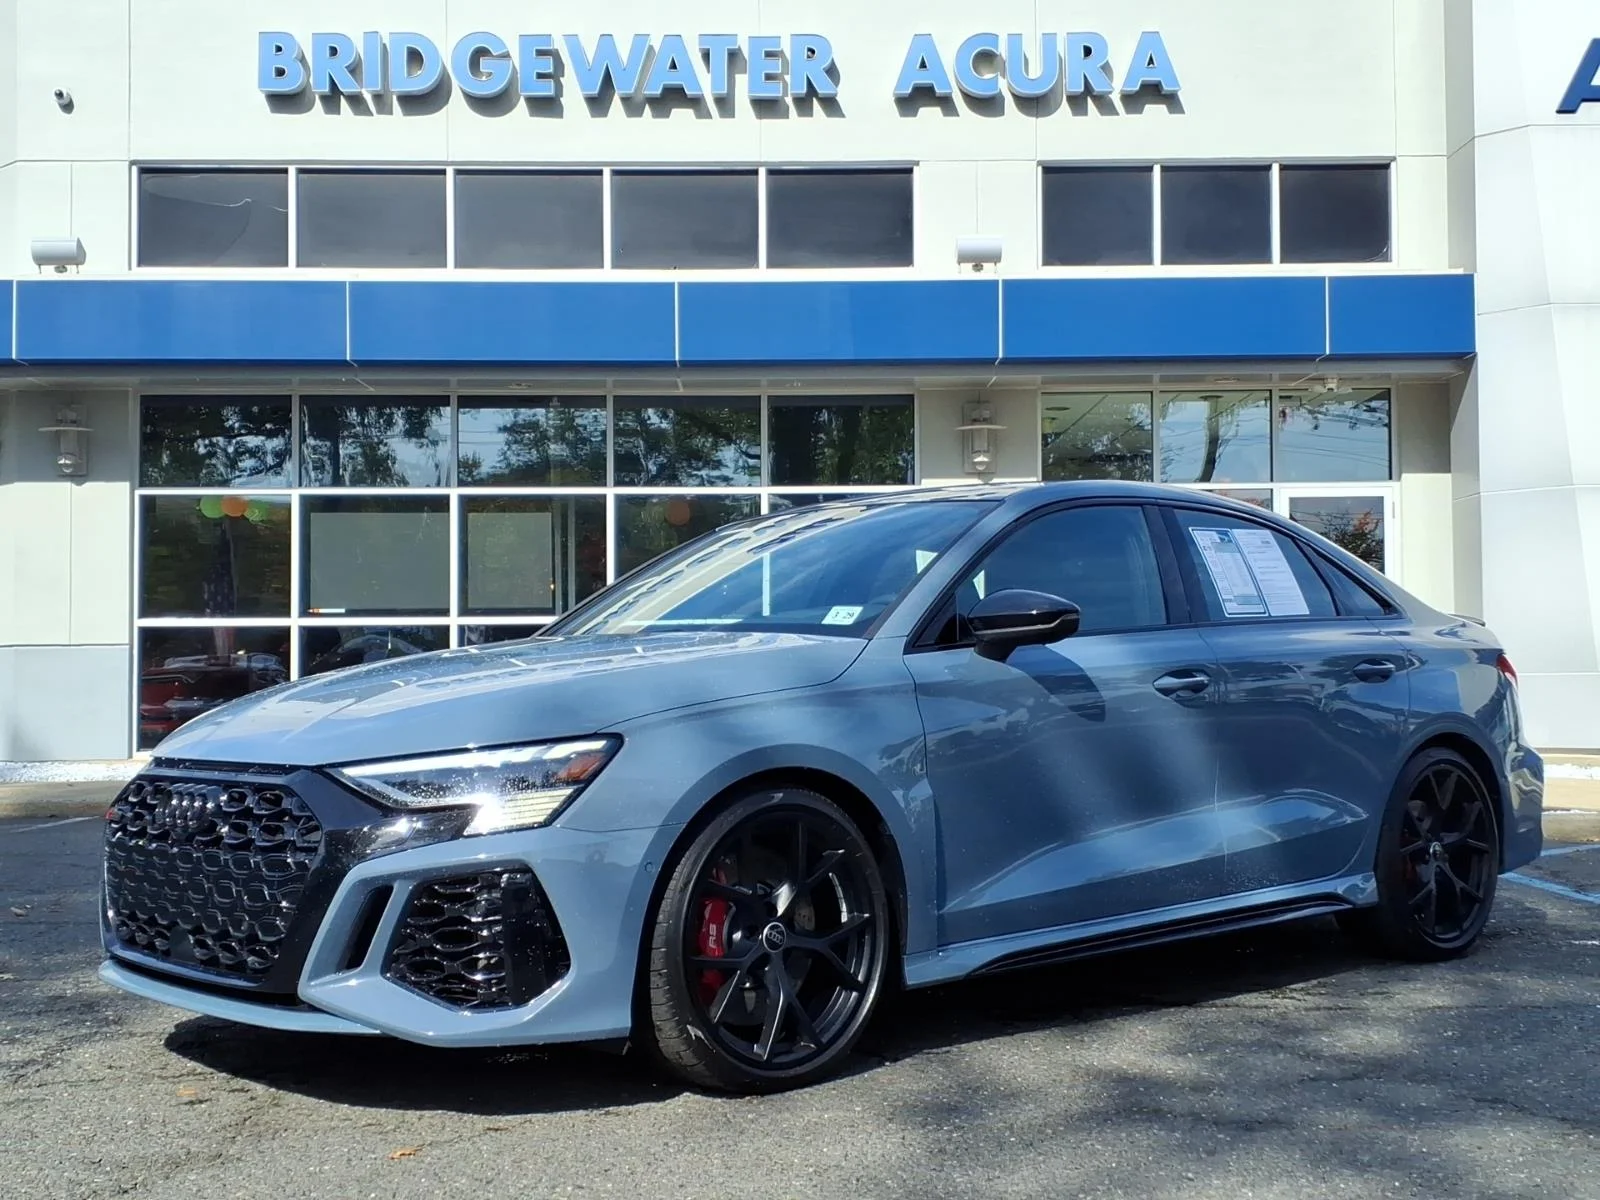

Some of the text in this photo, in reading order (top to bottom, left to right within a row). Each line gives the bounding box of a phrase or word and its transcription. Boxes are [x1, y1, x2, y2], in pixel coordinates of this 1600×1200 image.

[258, 31, 1181, 98] BRIDGEWATER ACURA
[708, 923, 718, 949] RS
